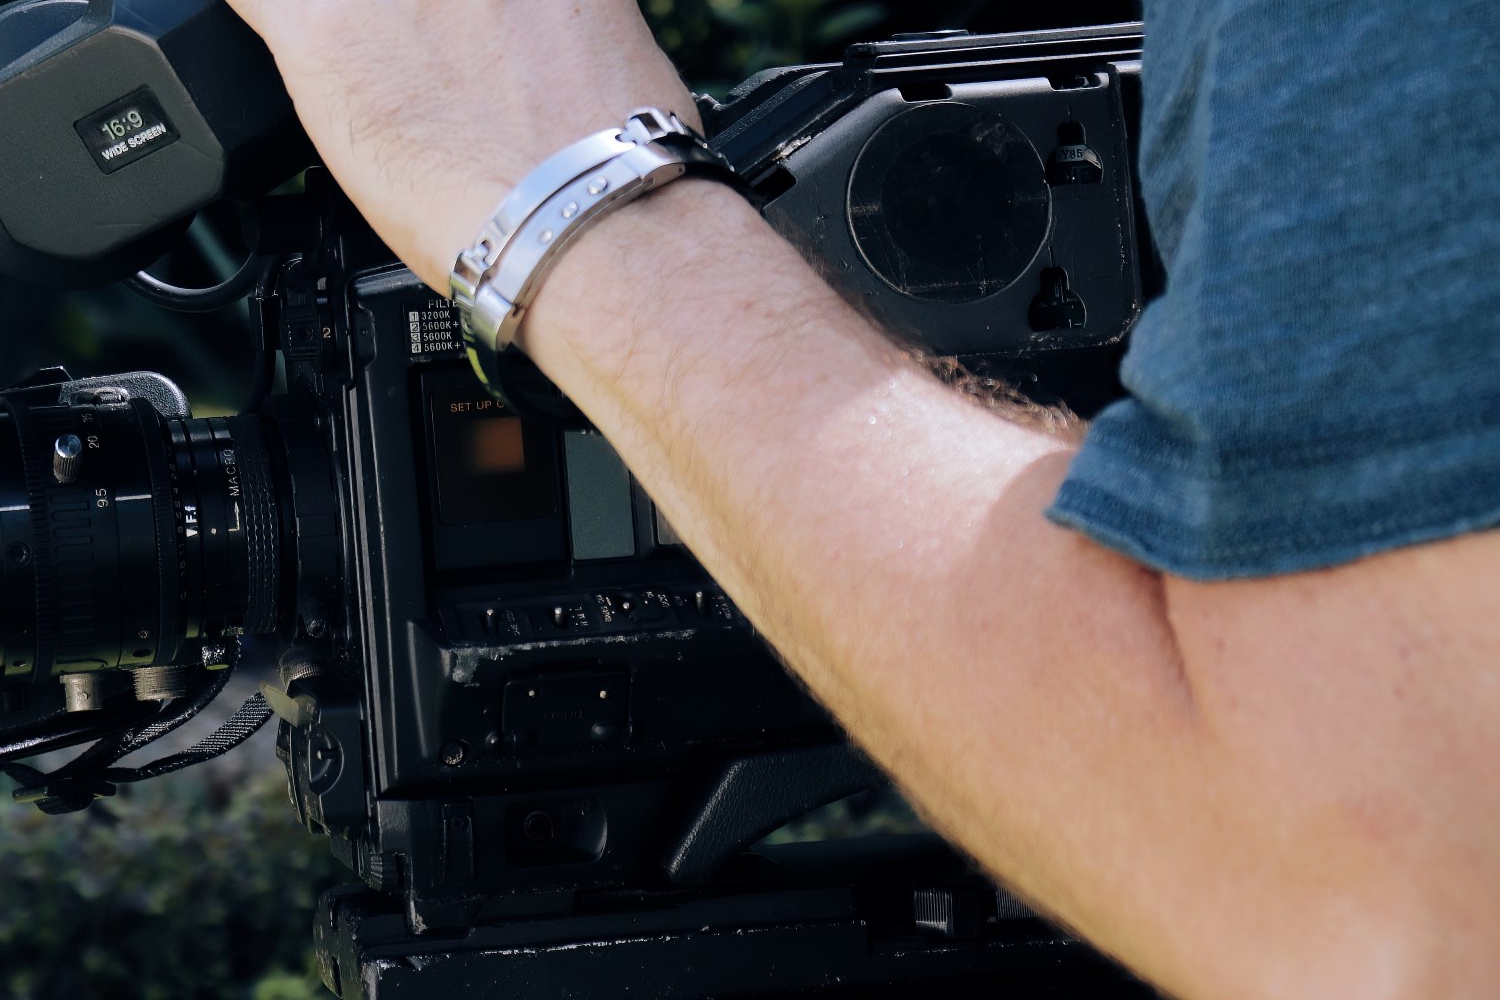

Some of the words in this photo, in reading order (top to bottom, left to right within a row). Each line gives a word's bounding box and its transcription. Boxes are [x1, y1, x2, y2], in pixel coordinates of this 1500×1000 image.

[101, 110, 143, 140] 16:9
[101, 141, 129, 160] WIDE
[127, 122, 167, 148] SCREEN
[428, 299, 458, 309] FILTE
[421, 310, 450, 321] 3200K
[423, 331, 452, 342] 5600K
[450, 402, 471, 413] SET
[476, 400, 492, 410] UP
[87, 435, 100, 449] 20
[223, 449, 240, 497] MACRO
[95, 488, 108, 507] 9.5
